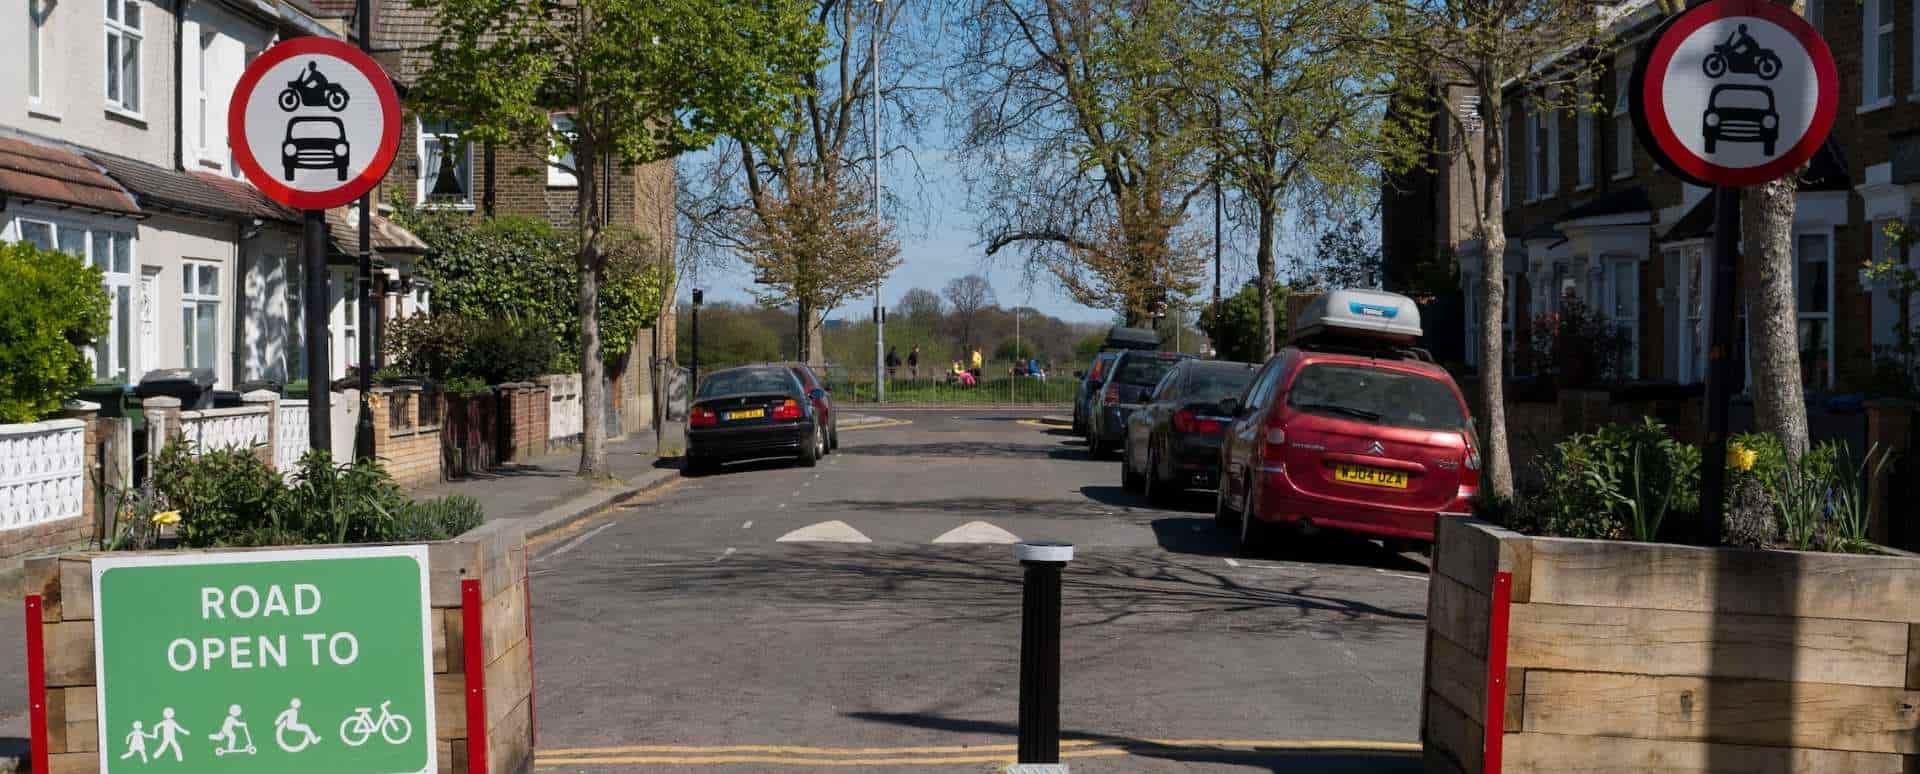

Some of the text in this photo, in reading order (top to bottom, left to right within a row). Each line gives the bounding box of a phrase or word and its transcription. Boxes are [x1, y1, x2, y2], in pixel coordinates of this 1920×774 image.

[201, 583, 322, 619] ROAD
[167, 631, 359, 671] OPEN TO
